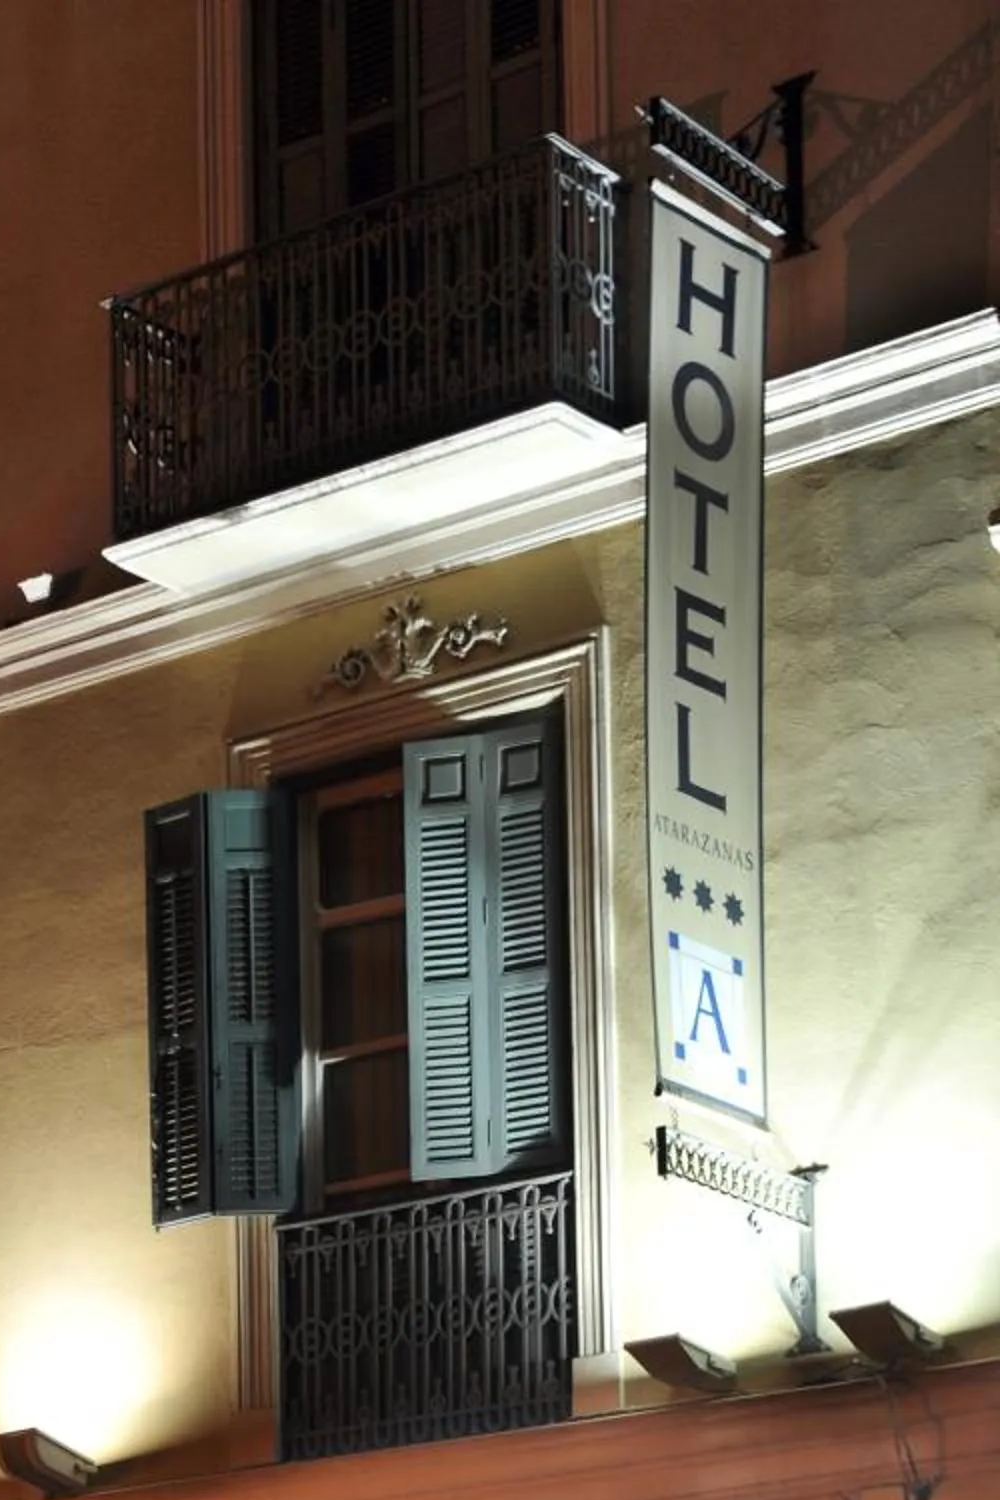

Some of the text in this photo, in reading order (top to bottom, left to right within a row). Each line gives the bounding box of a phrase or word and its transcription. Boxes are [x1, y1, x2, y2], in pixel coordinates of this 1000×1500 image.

[671, 237, 740, 815] HOTEL
[653, 812, 755, 872] ATARAZANAS
[689, 968, 731, 1055] A
